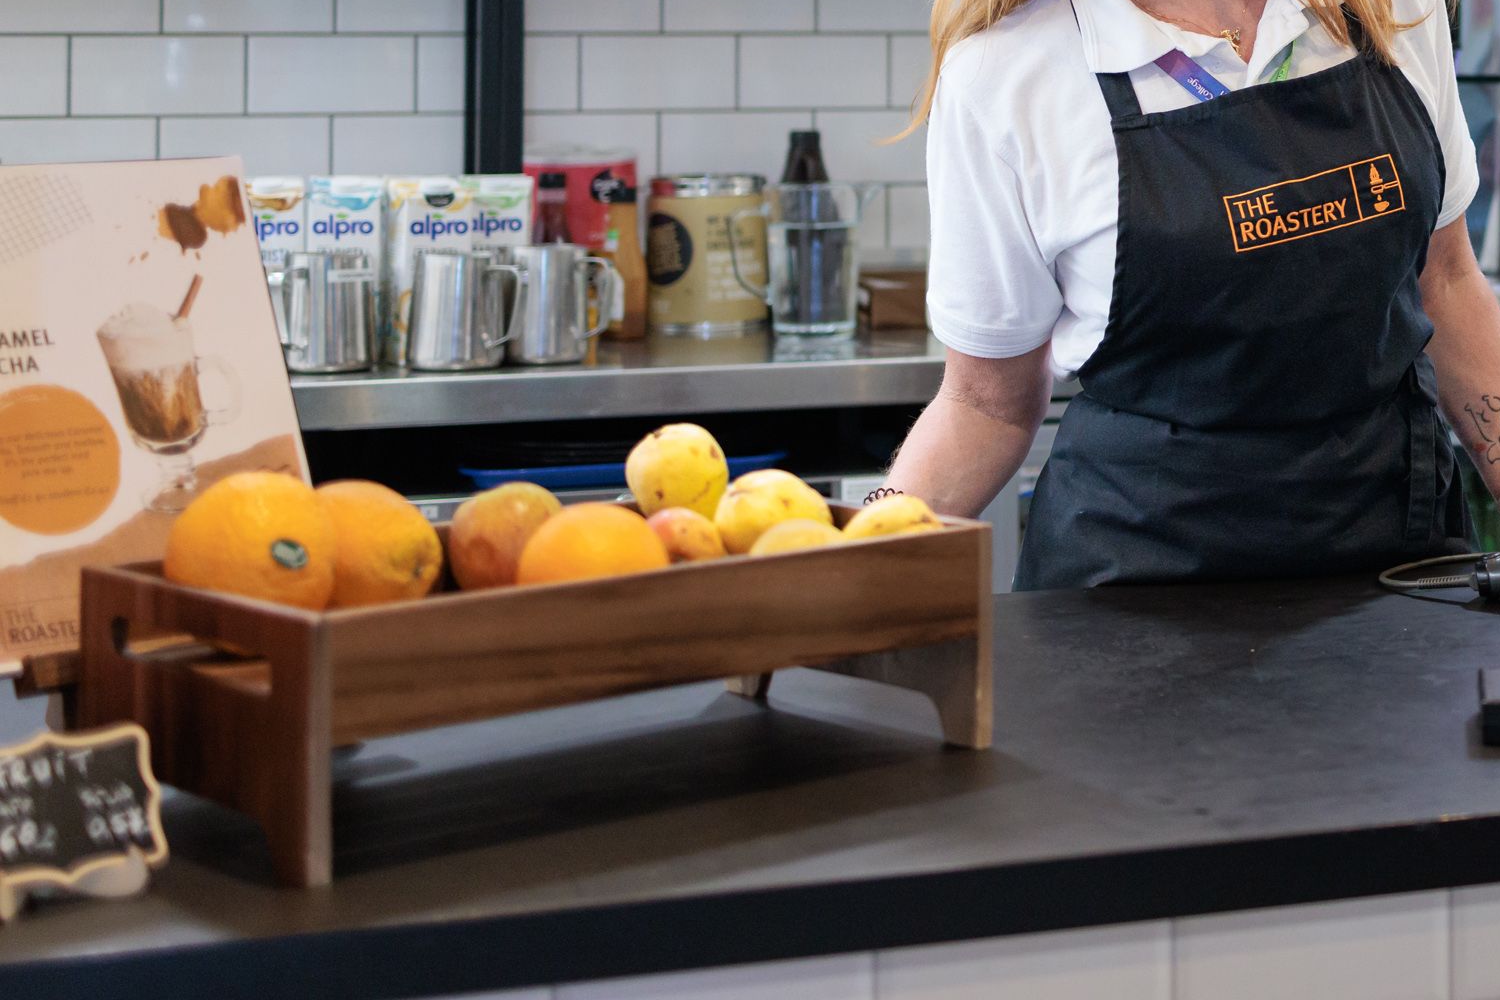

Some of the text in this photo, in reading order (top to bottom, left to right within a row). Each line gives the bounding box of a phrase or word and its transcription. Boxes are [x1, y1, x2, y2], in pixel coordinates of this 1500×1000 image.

[1187, 76, 1214, 101] College
[1233, 193, 1278, 219] THE
[254, 215, 299, 241] lpro
[312, 214, 374, 240] alpro
[410, 214, 468, 240] alpro
[1239, 198, 1348, 242] ROASTERY
